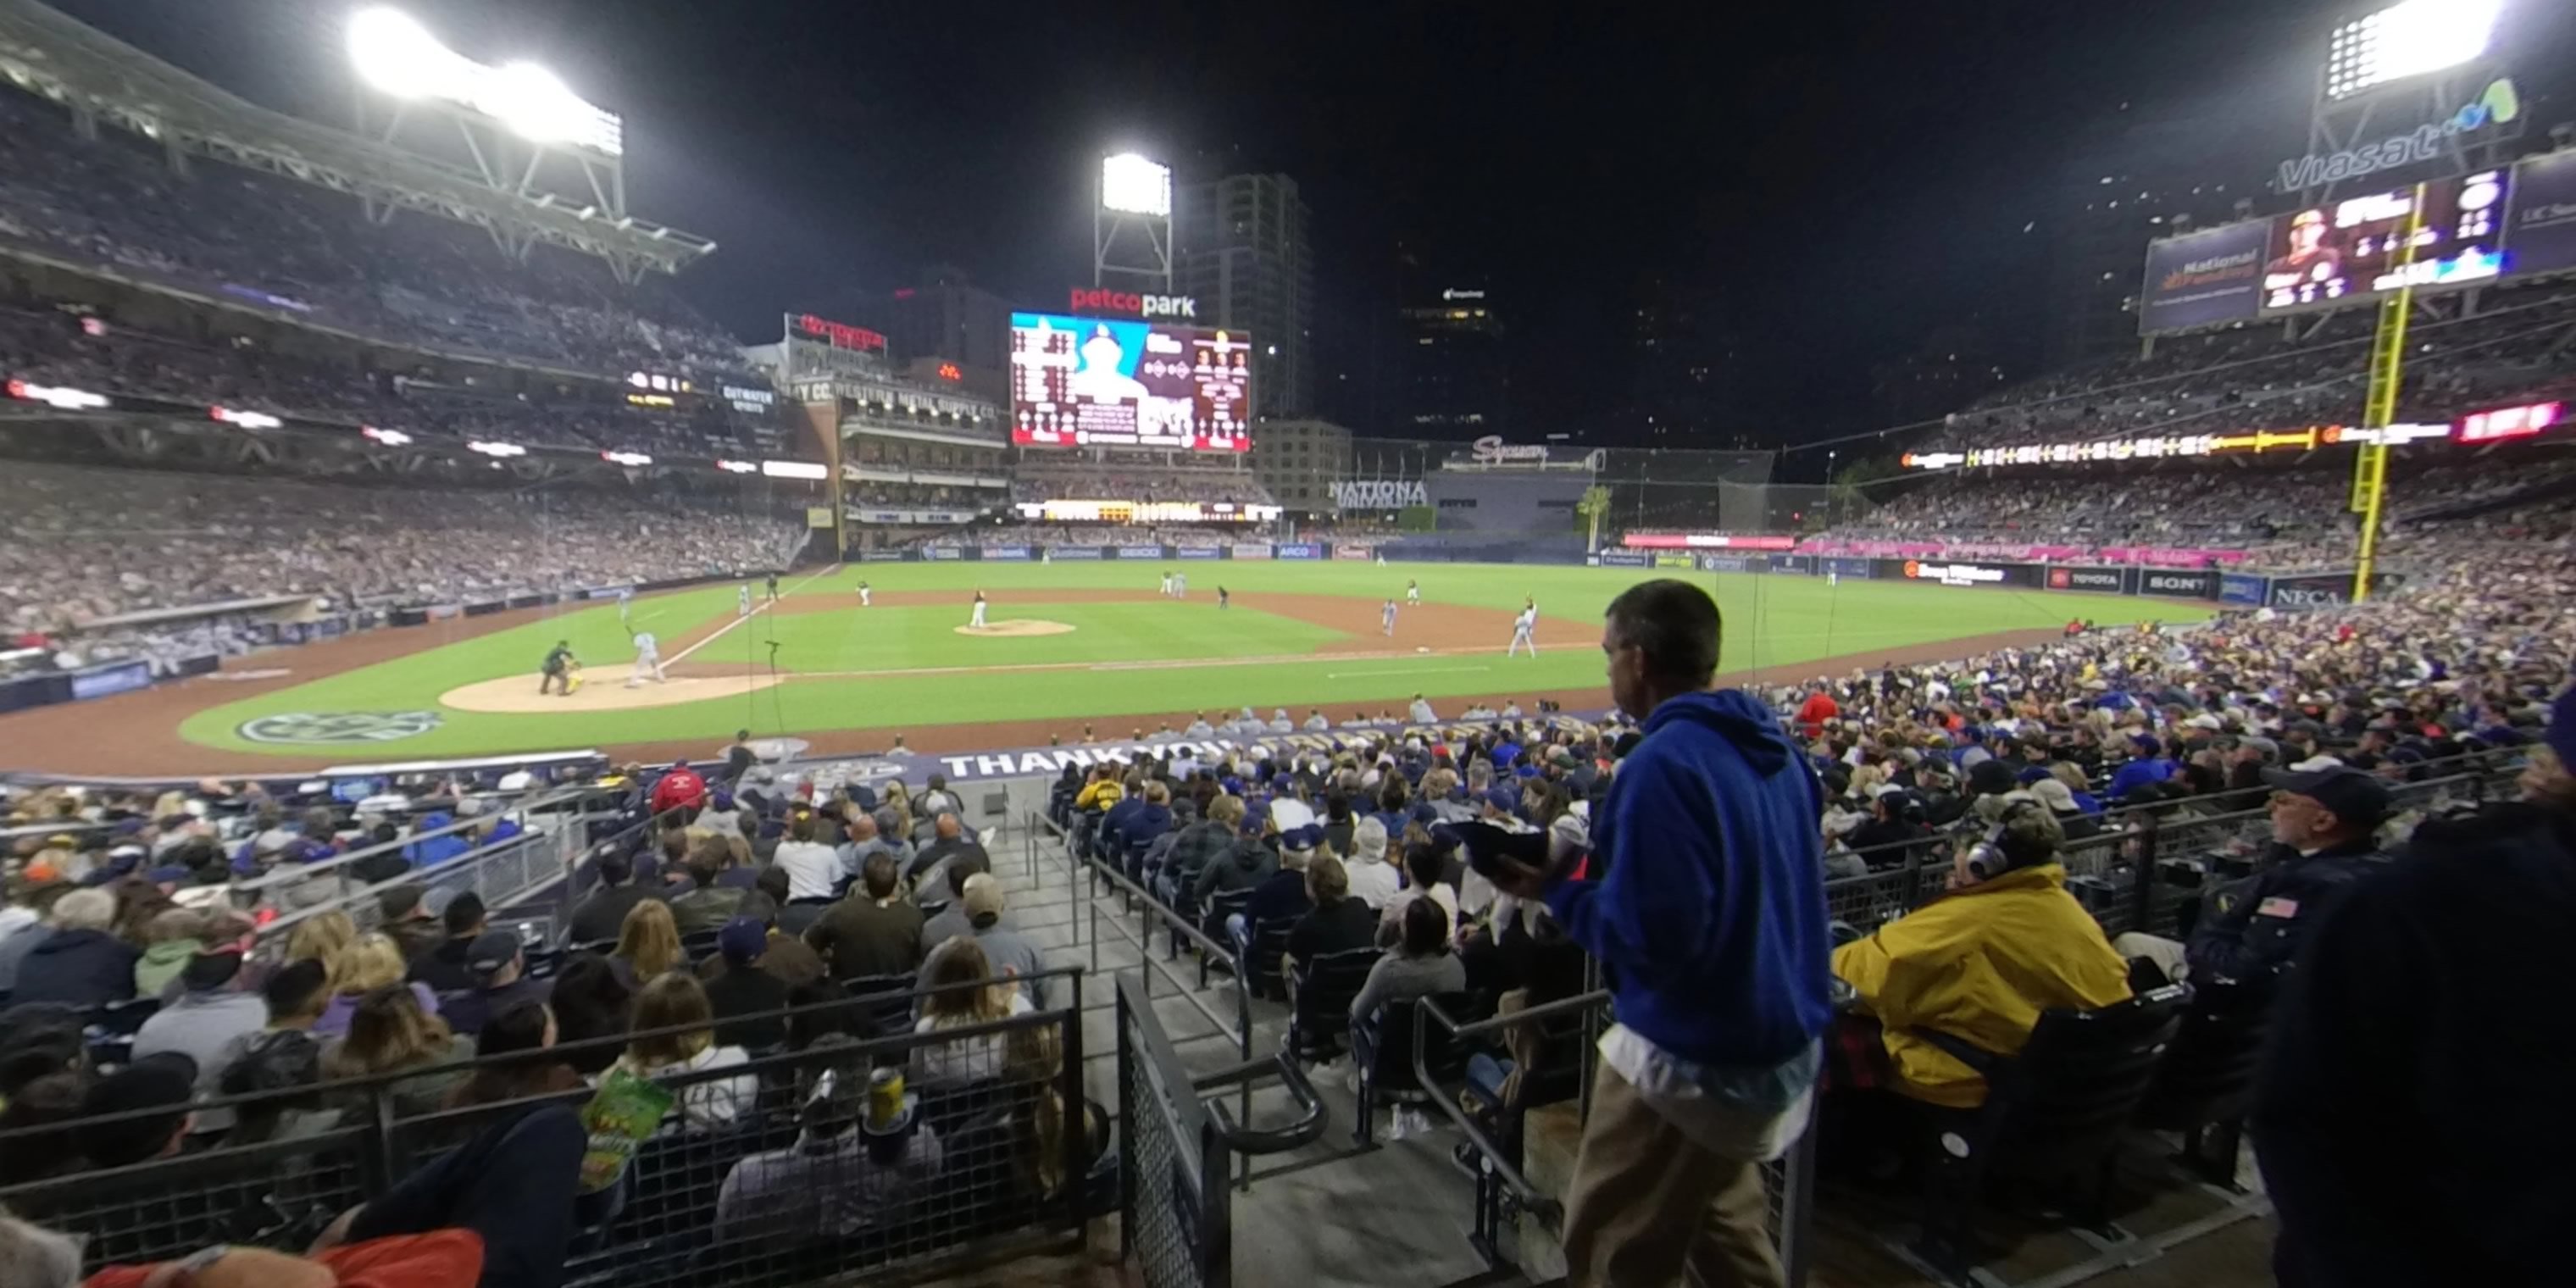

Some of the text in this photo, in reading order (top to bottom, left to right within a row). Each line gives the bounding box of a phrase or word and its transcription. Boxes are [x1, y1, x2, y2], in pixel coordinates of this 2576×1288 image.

[2279, 125, 2438, 192] Viasat
[1119, 547, 1160, 558] GEICO
[1280, 547, 1308, 558] ARCO
[2072, 574, 2118, 585] TOYOTA
[940, 746, 1133, 778] THANK
